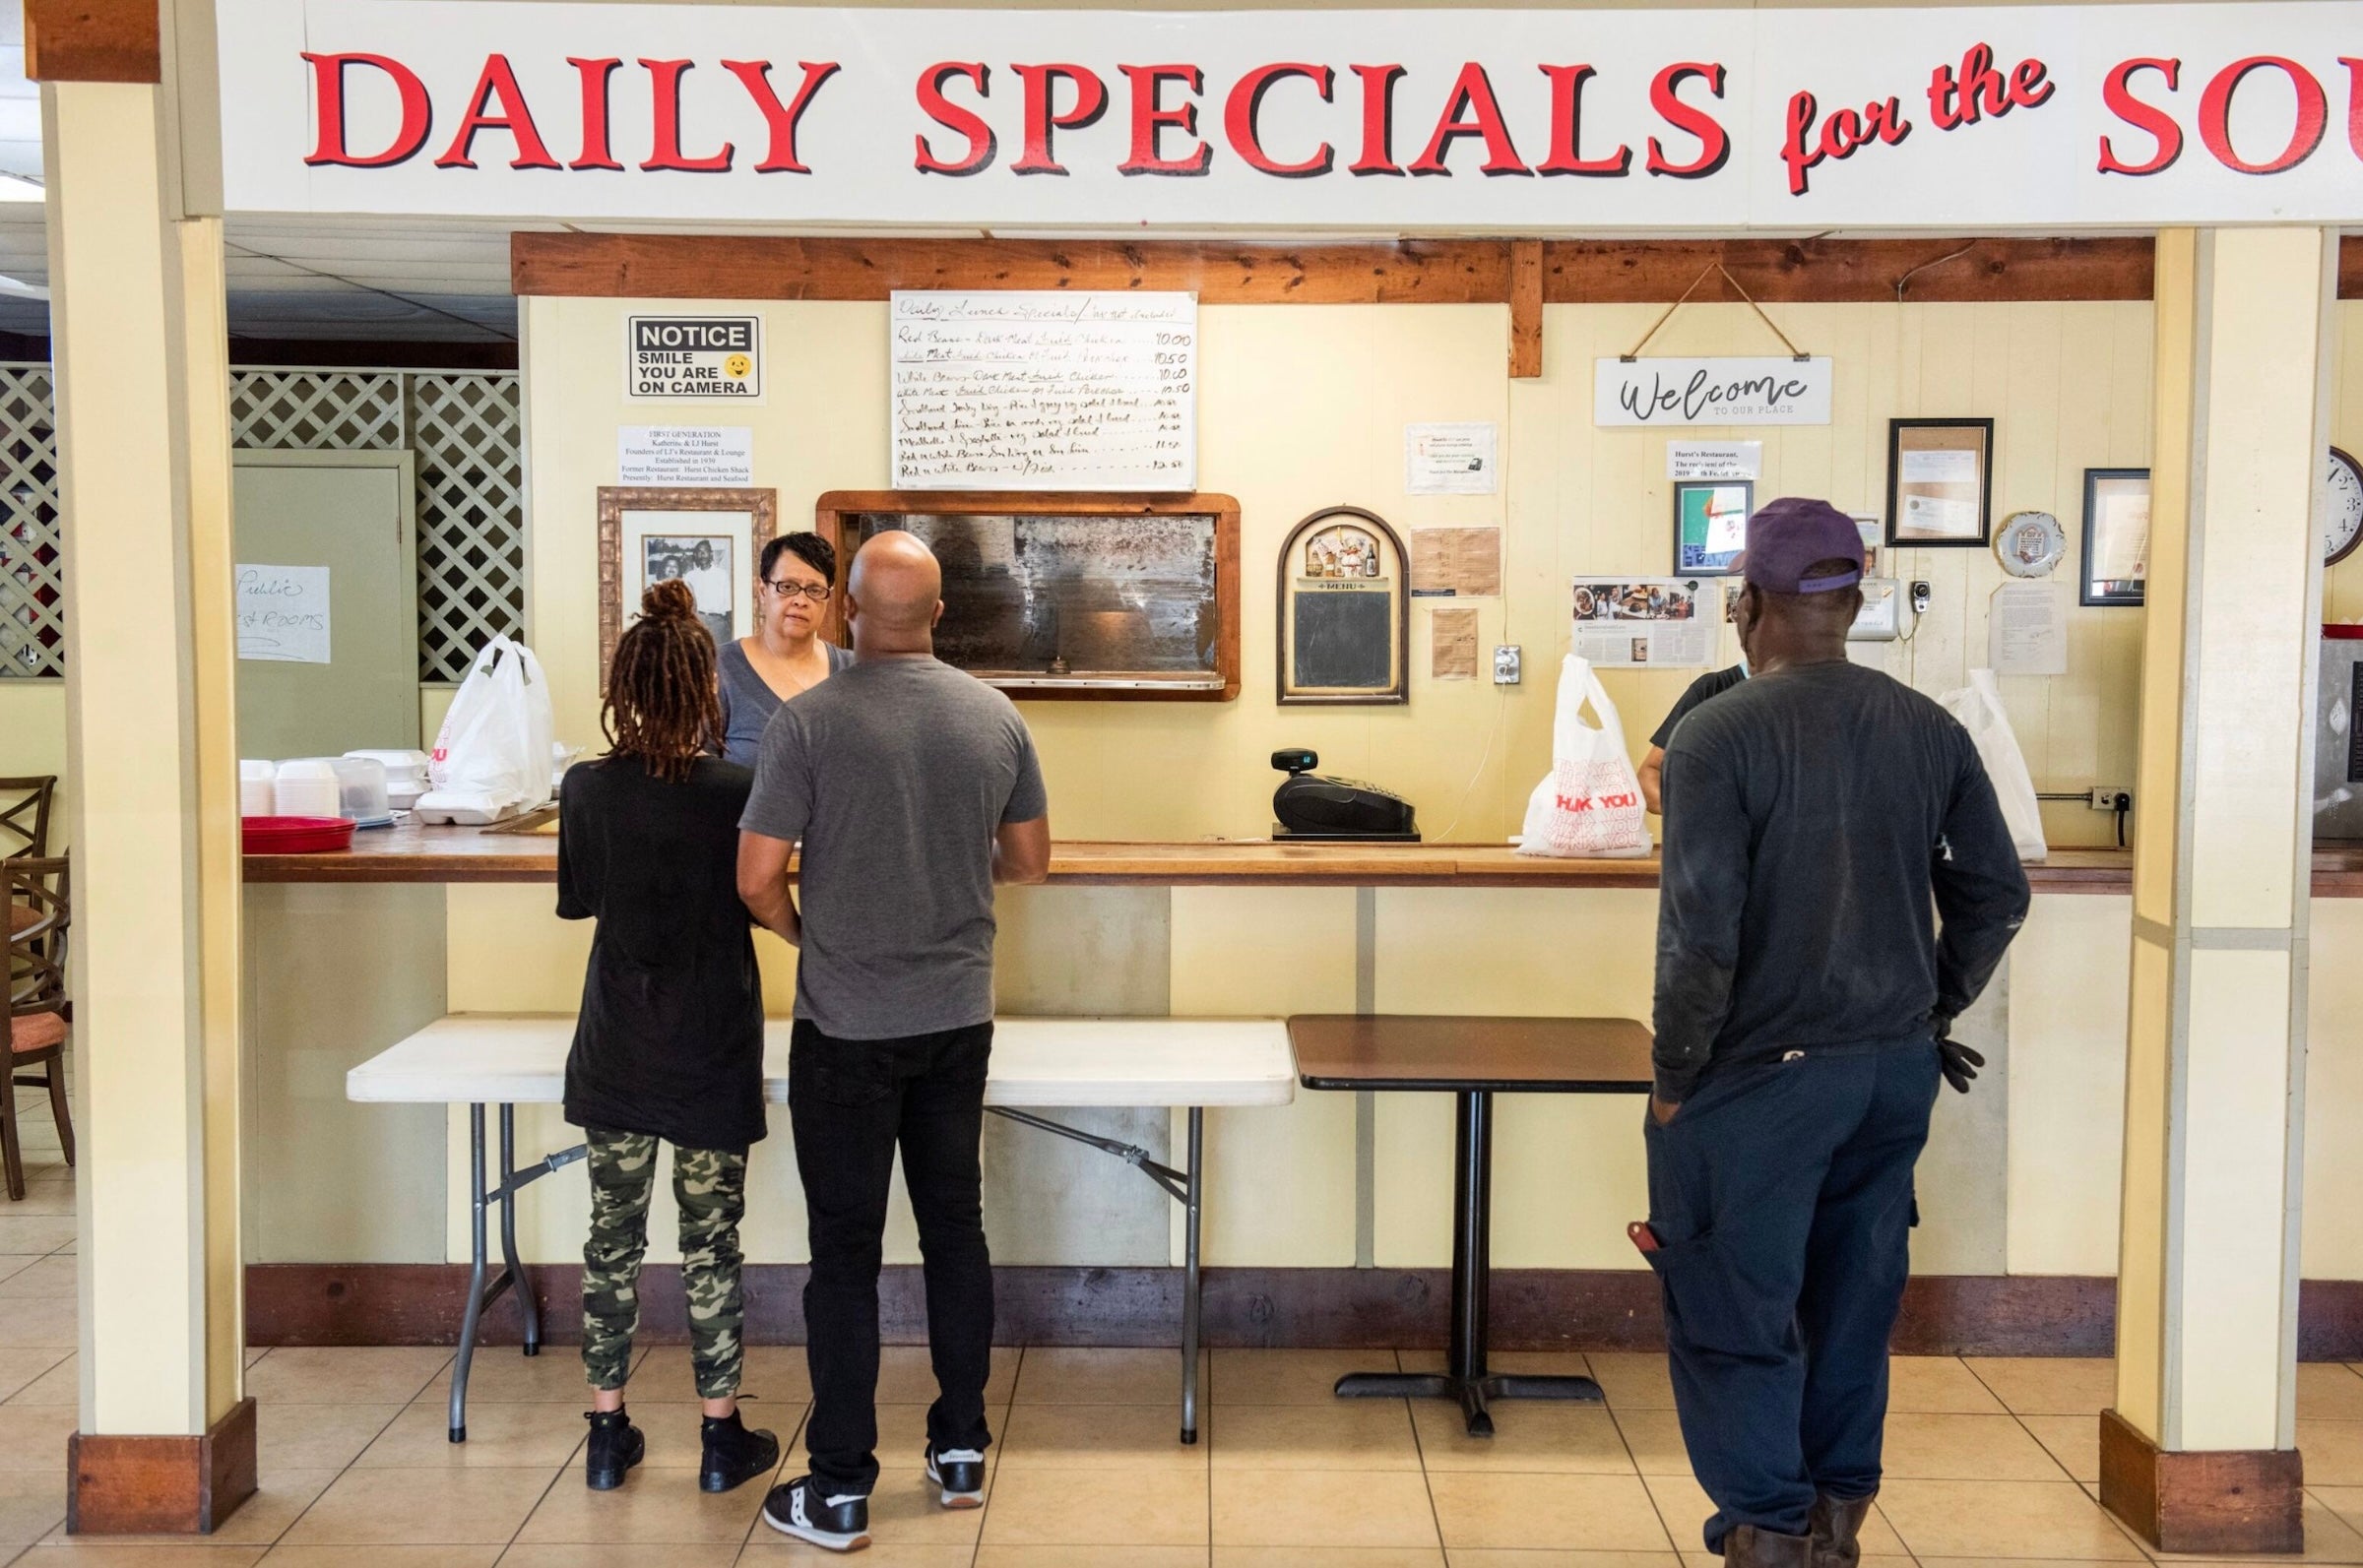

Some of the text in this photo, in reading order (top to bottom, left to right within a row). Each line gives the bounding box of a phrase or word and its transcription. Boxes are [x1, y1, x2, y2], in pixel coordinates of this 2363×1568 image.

[299, 41, 2363, 196] DAILY SPECIALS for the SO
[641, 326, 746, 346] NOTICE
[898, 325, 923, 345] Red
[638, 352, 693, 364] SMILE
[638, 367, 719, 379] YOU ARE
[638, 381, 748, 394] ON CAMERA
[1621, 369, 1809, 420] Welcome
[1714, 405, 1795, 415] TO OUR PLACE
[625, 448, 655, 457] Founders
[721, 449, 746, 458] Lounge
[2338, 475, 2348, 490] 2
[2346, 497, 2356, 512] 3
[2337, 518, 2348, 533] 4
[236, 569, 304, 597] Public
[1599, 791, 1636, 809] YOU
